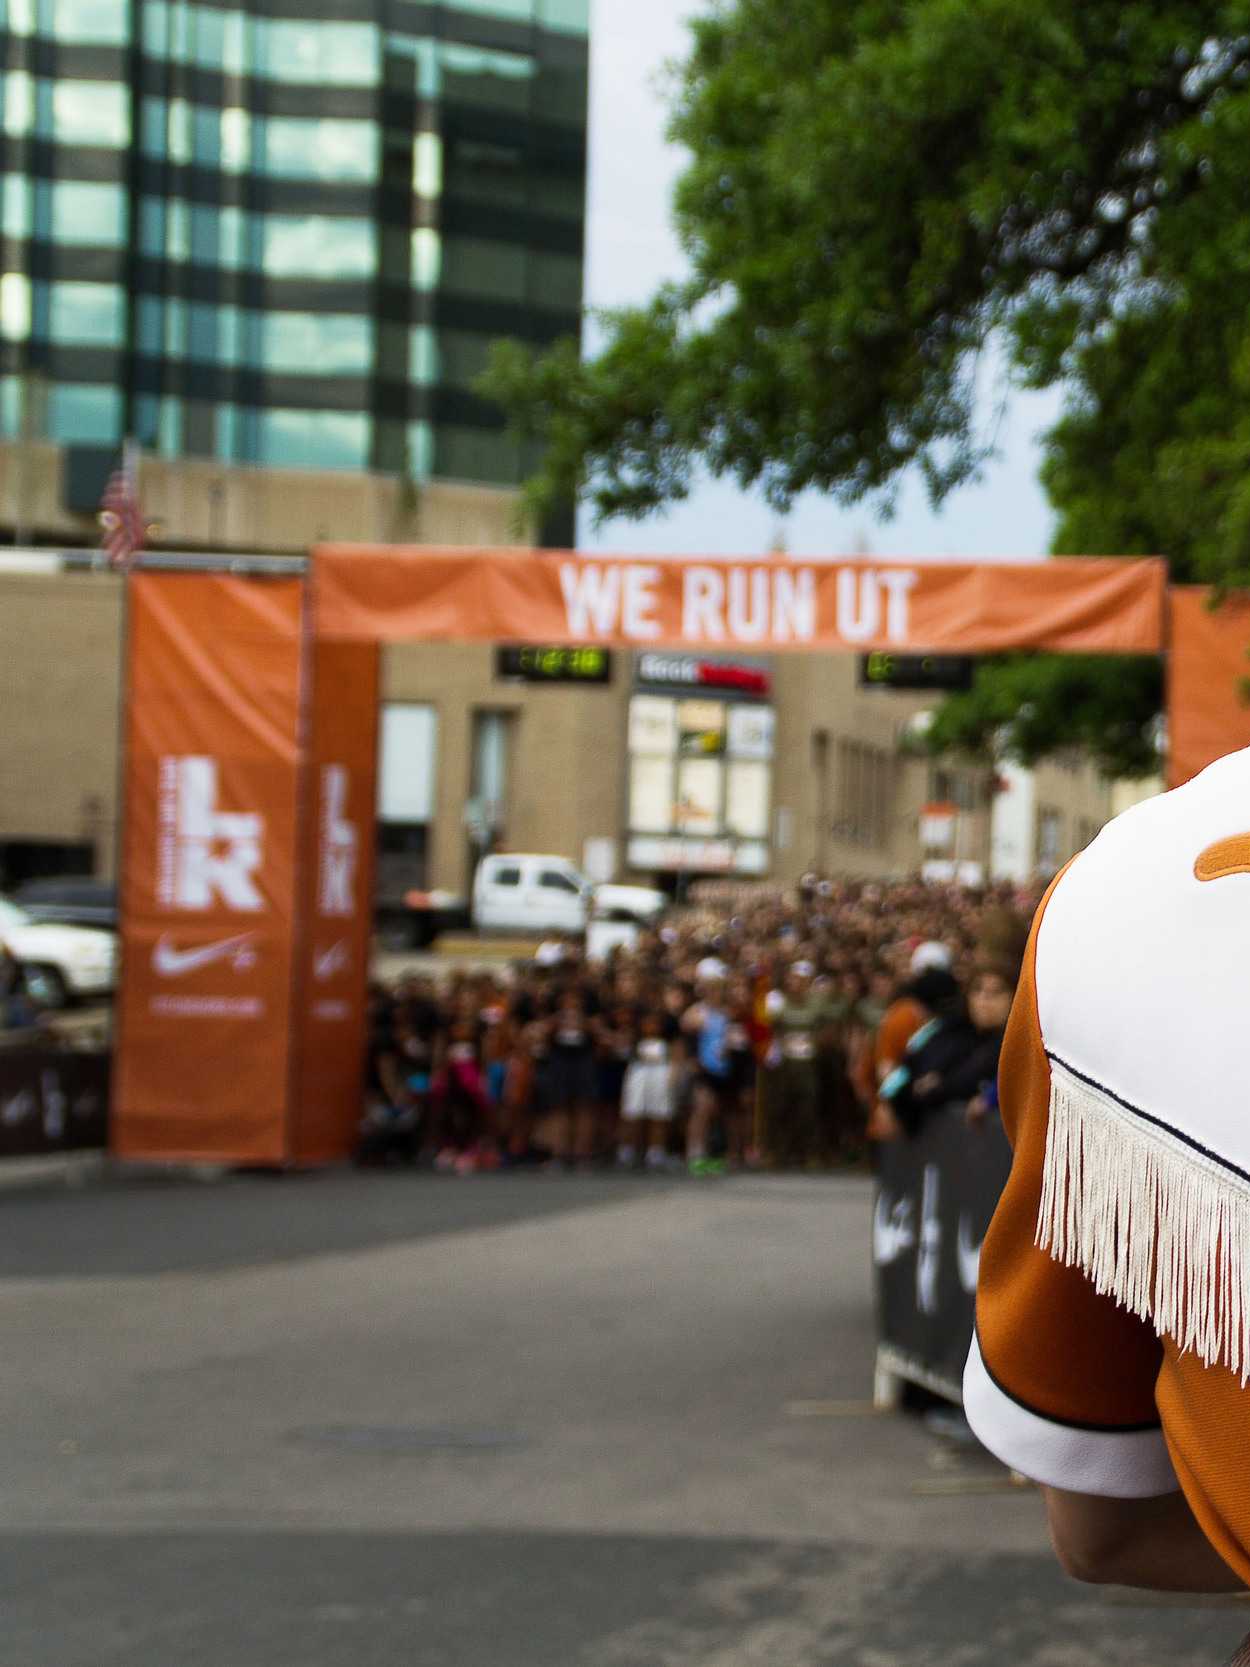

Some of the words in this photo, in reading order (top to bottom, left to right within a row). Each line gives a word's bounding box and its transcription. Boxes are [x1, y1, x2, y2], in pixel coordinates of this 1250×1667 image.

[559, 562, 661, 640] WE
[681, 565, 816, 642] RUN
[836, 568, 916, 643] UT
